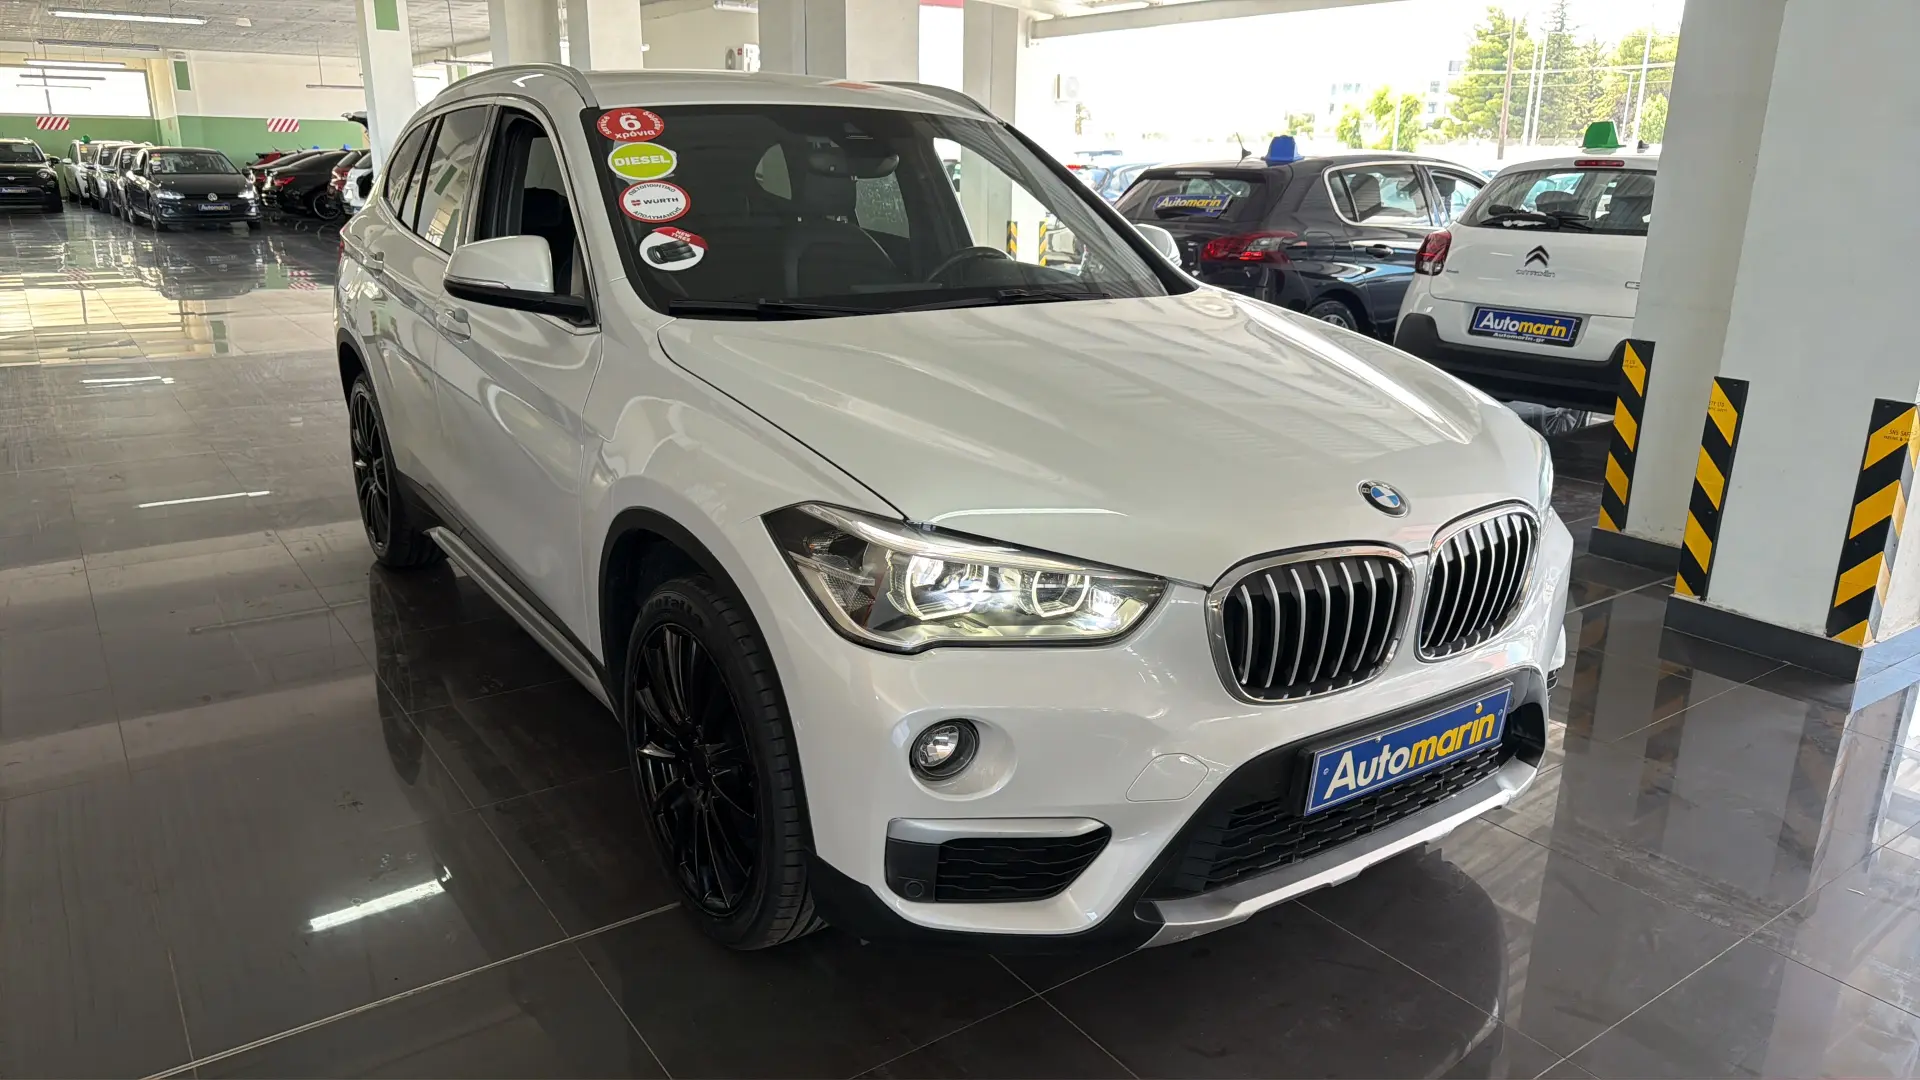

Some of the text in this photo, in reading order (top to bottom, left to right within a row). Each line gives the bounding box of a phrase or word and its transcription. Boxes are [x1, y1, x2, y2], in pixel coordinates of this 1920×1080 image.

[619, 114, 642, 131] 6
[615, 130, 656, 139] χρόνια
[614, 155, 670, 167] DIESEL
[1157, 195, 1221, 208] Automarin
[1479, 312, 1567, 337] Automarin
[1493, 332, 1545, 343] Automarin.gr
[1323, 702, 1495, 800] Automarin
